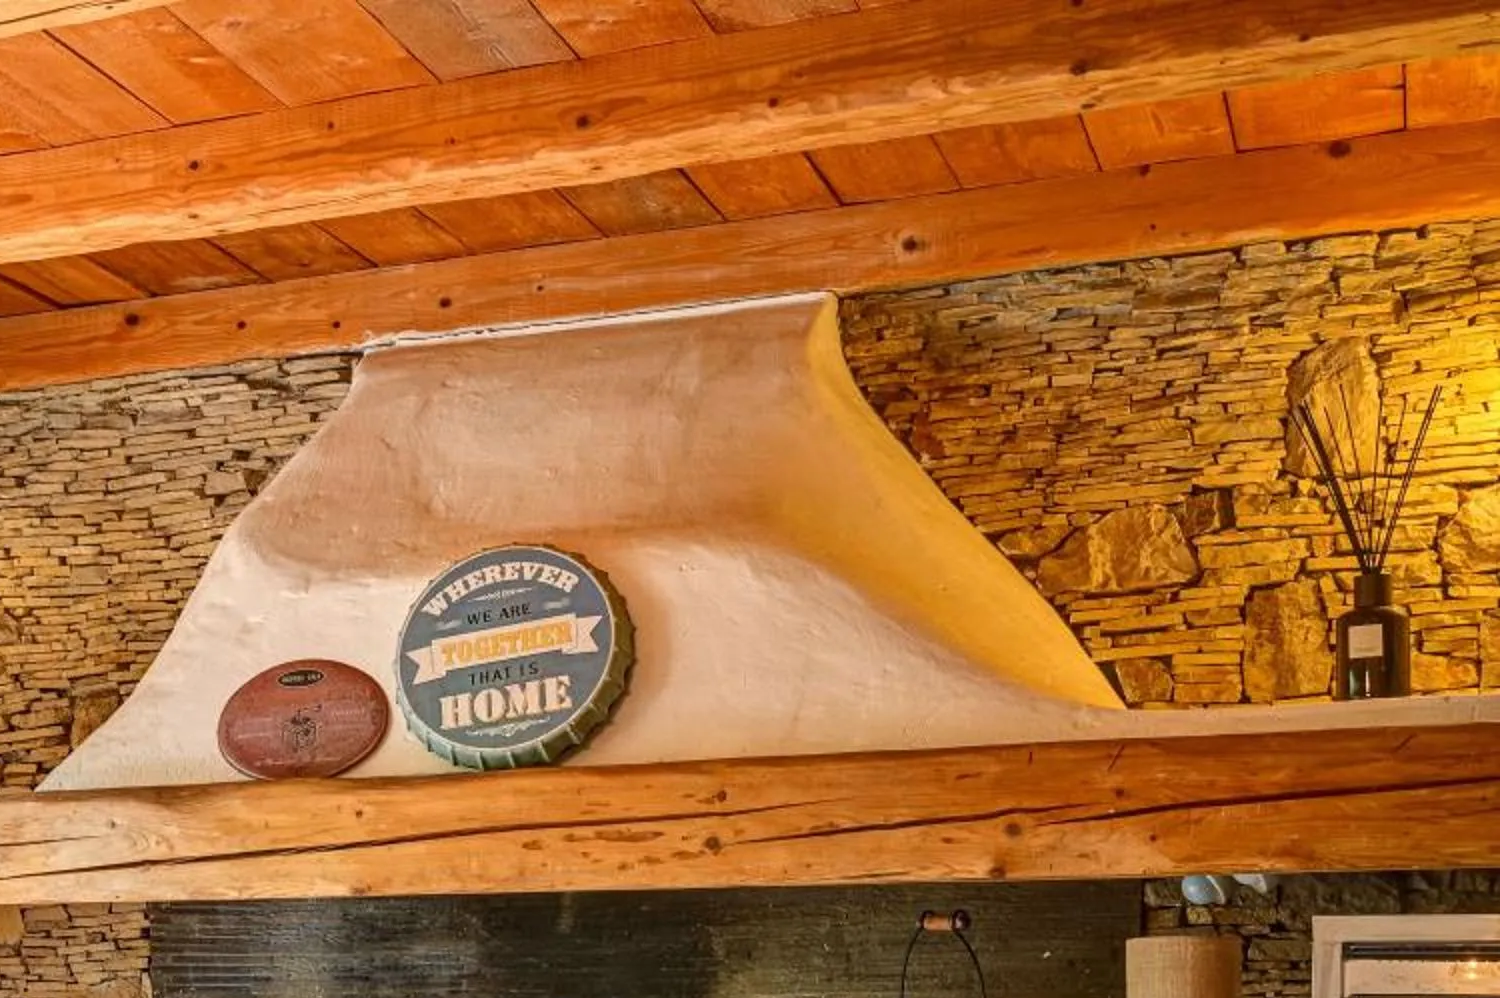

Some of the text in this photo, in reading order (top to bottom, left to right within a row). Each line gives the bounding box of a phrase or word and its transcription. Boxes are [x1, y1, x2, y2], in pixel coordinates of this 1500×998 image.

[421, 562, 580, 616] WHEREVER
[467, 603, 533, 625] WE ARE
[440, 619, 573, 667] TOGETHER
[468, 661, 539, 686] THAT IS
[438, 675, 573, 731] HOME
